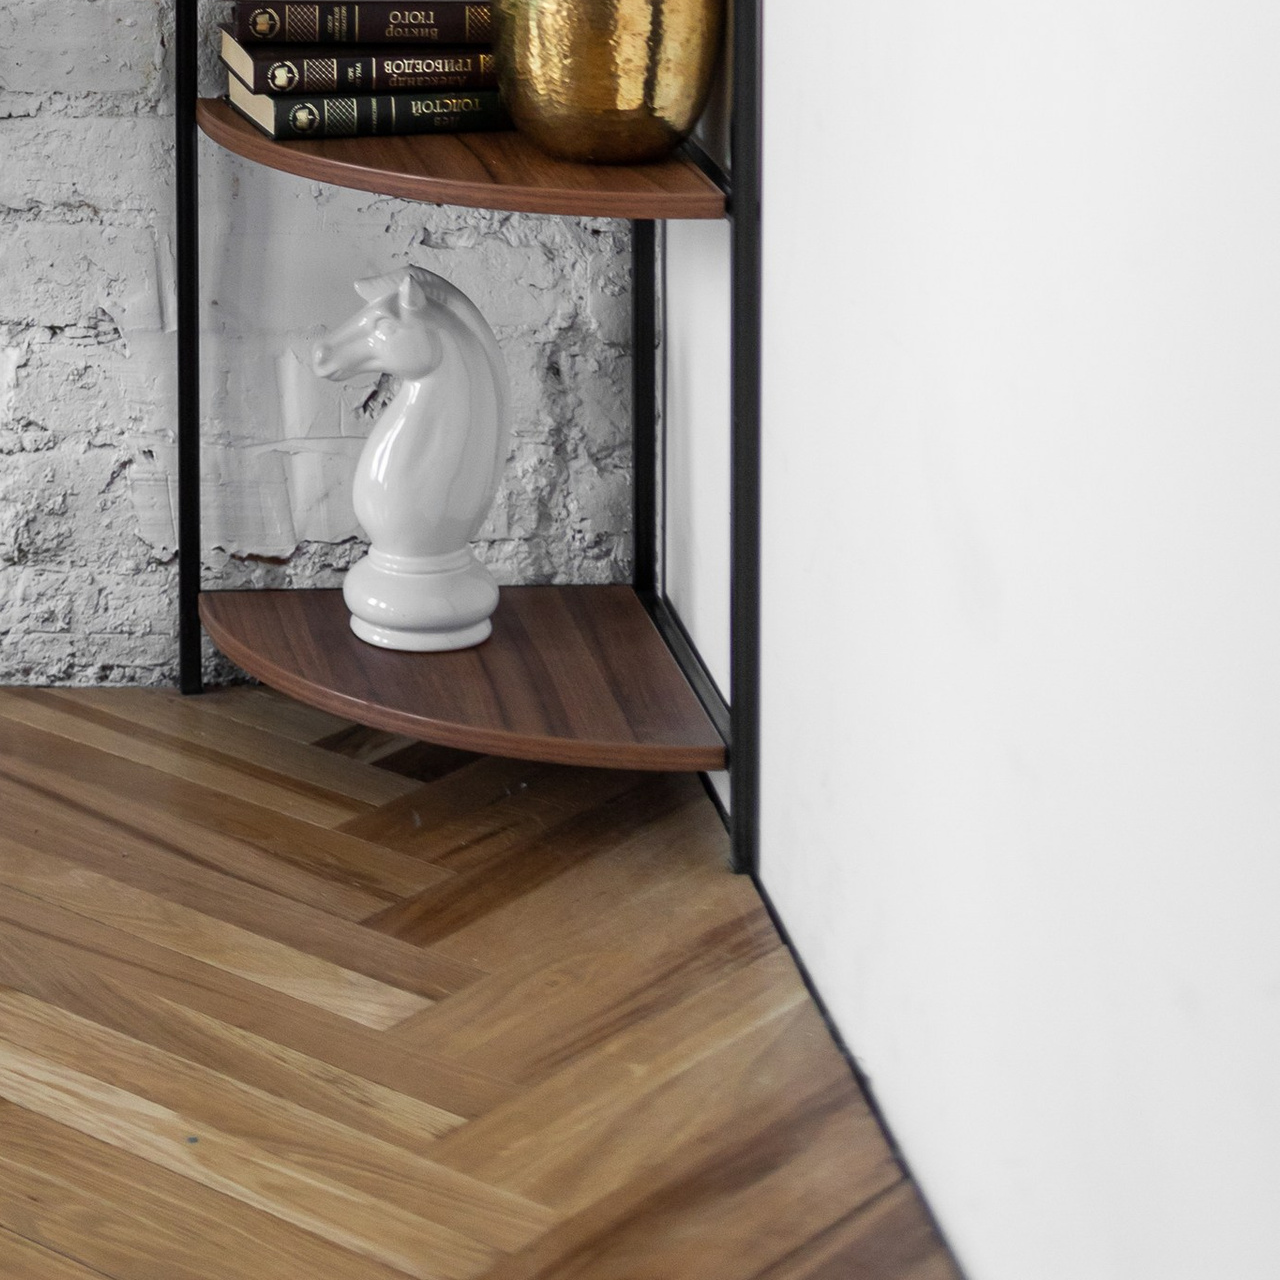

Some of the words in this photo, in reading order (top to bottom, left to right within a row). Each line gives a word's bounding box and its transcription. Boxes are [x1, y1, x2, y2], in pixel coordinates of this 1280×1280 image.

[389, 11, 435, 24] ГЮГО
[385, 25, 439, 39] Виктор
[384, 58, 472, 73] ГРИБОЕДОВ
[388, 74, 467, 87] Александр
[411, 98, 482, 116] ТОЛСТОЙ
